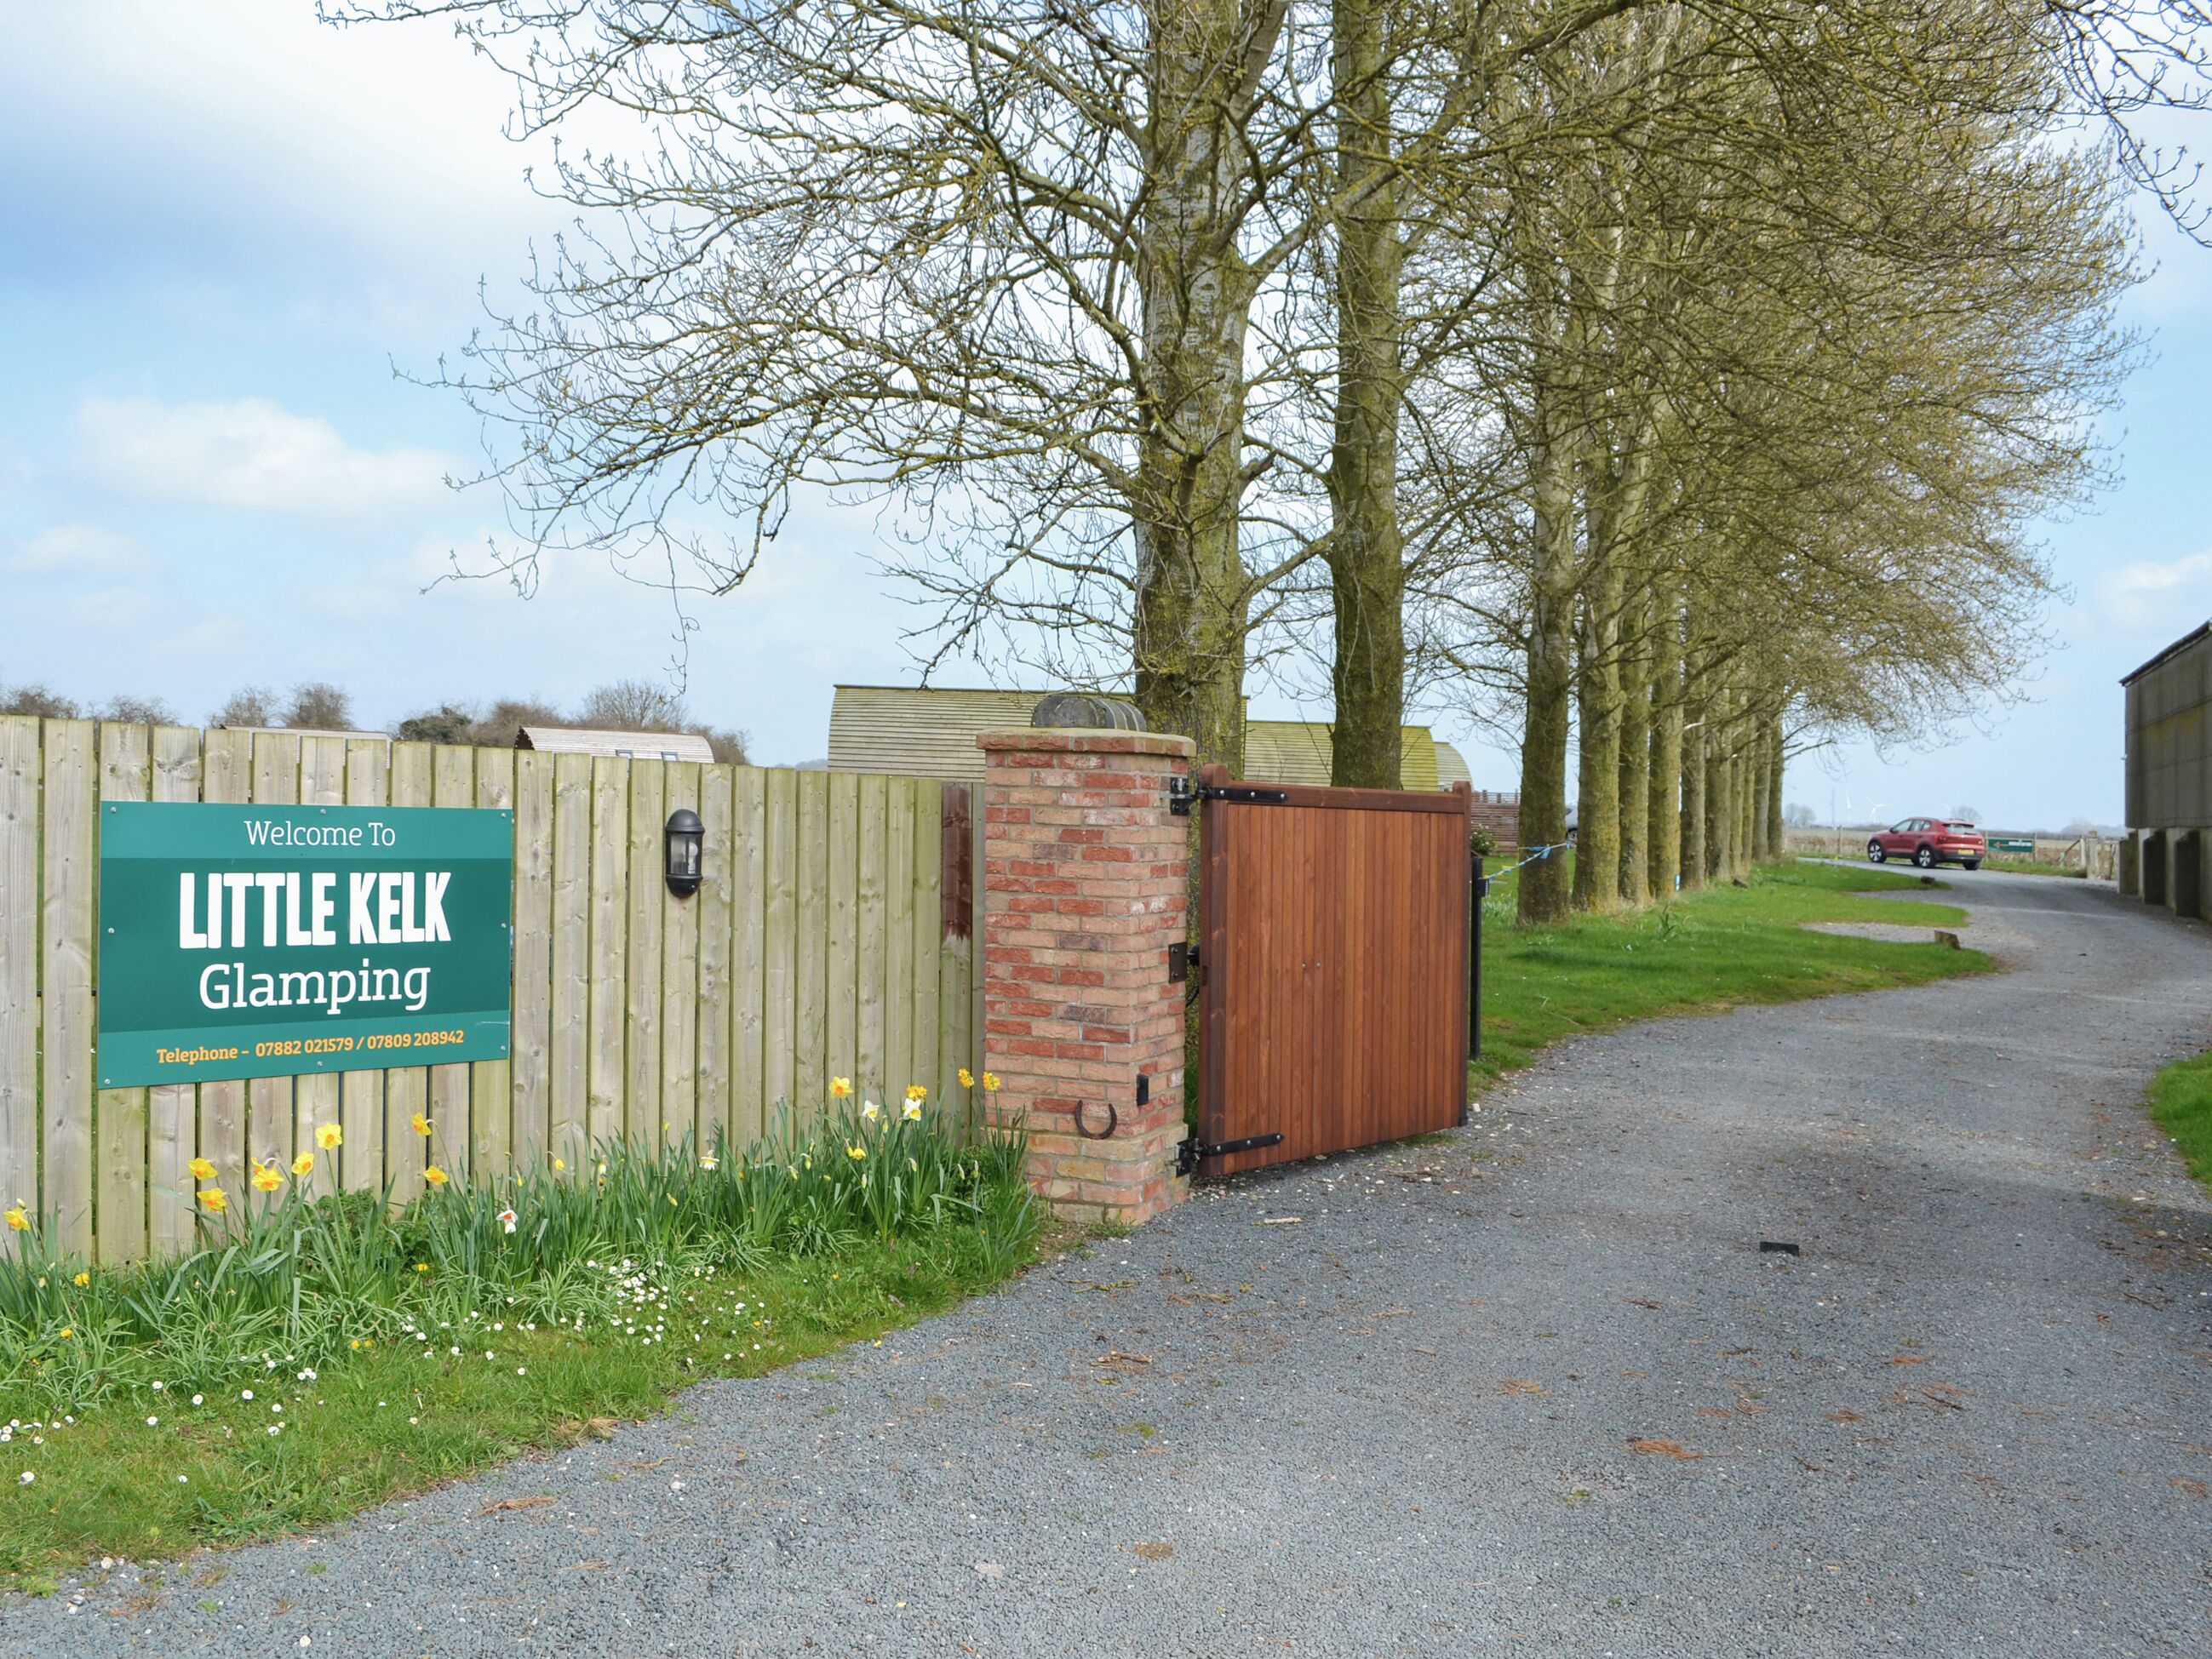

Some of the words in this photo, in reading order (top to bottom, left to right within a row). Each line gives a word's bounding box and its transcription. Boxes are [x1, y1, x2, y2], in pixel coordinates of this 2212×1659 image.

[244, 820, 363, 846] Welcome
[368, 821, 396, 847] To
[179, 872, 336, 949] LITTLE
[349, 871, 451, 945] KELK
[199, 958, 431, 1015] Glamping
[156, 1045, 239, 1066] Telephone
[255, 1039, 302, 1057] 07882
[304, 1036, 354, 1055] 021579
[366, 1033, 412, 1050] 07809
[413, 1029, 465, 1047] 208942
